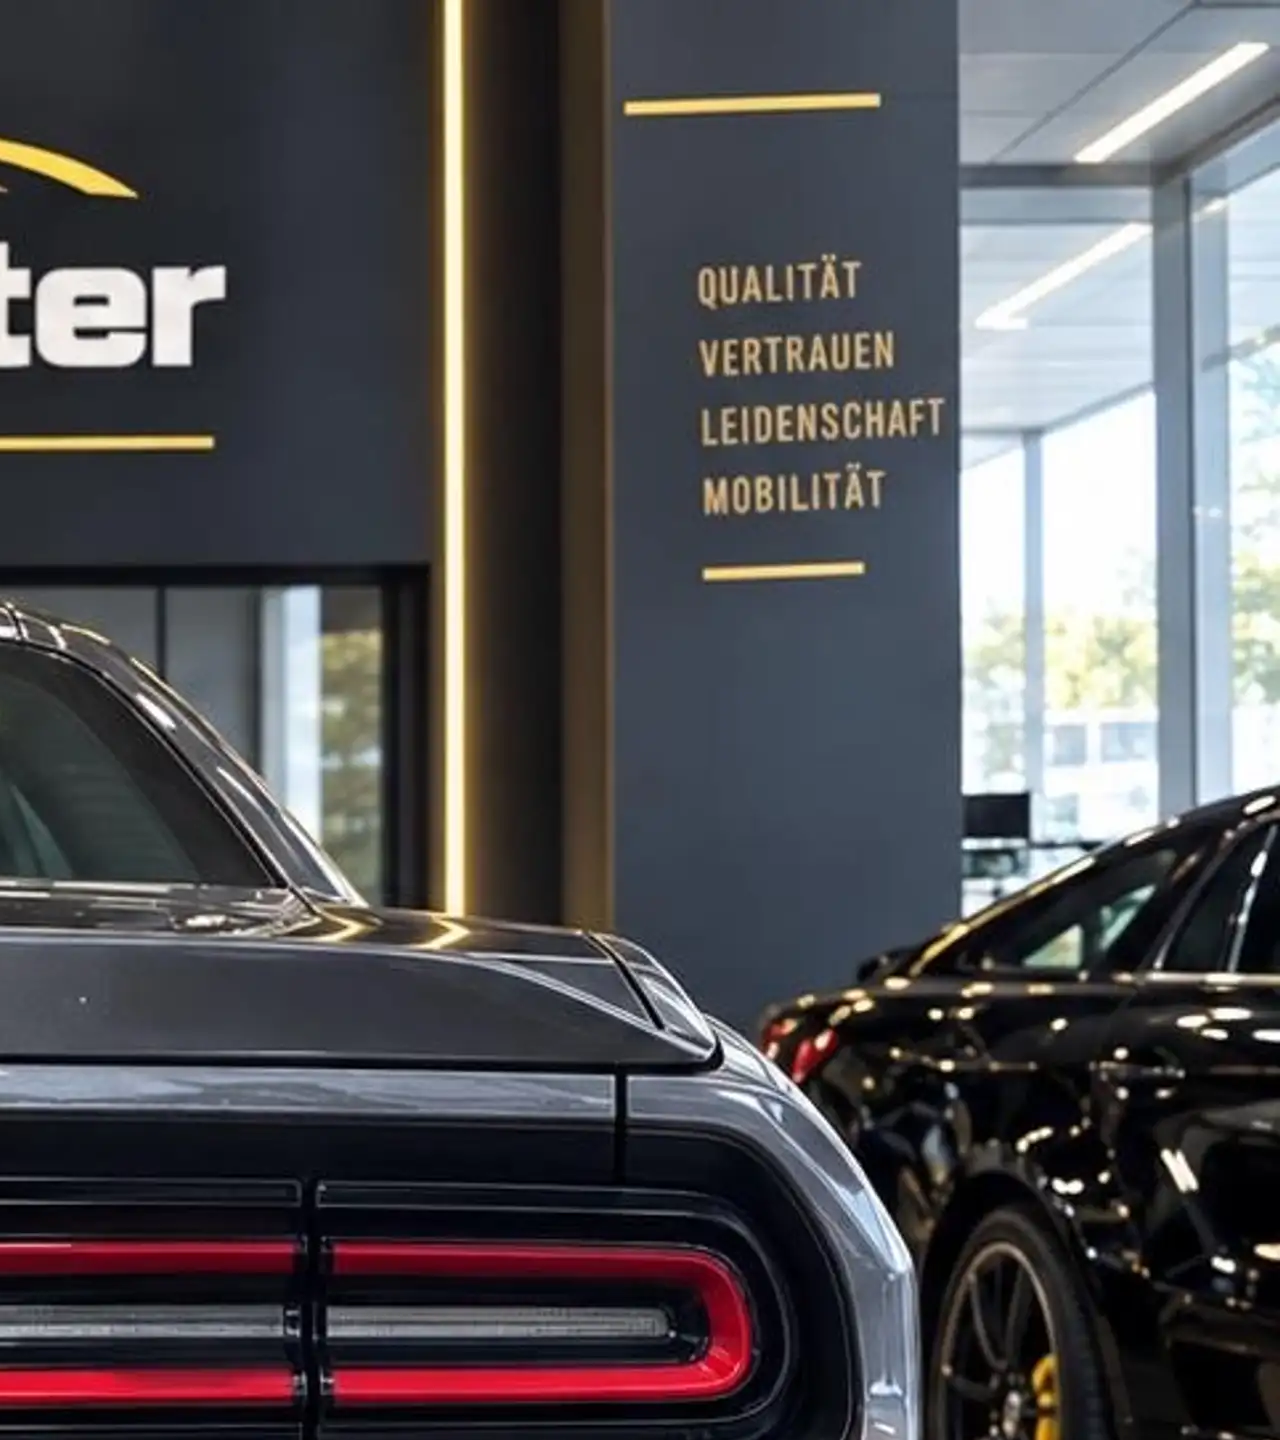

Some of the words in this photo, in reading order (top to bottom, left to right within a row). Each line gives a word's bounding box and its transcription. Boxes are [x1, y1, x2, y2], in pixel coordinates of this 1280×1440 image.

[698, 252, 862, 309] QUALITÄT
[699, 331, 894, 377] VERTRAUEN
[702, 397, 945, 446] LEIDENSCHAFT
[703, 462, 886, 515] MOBILITÄT
